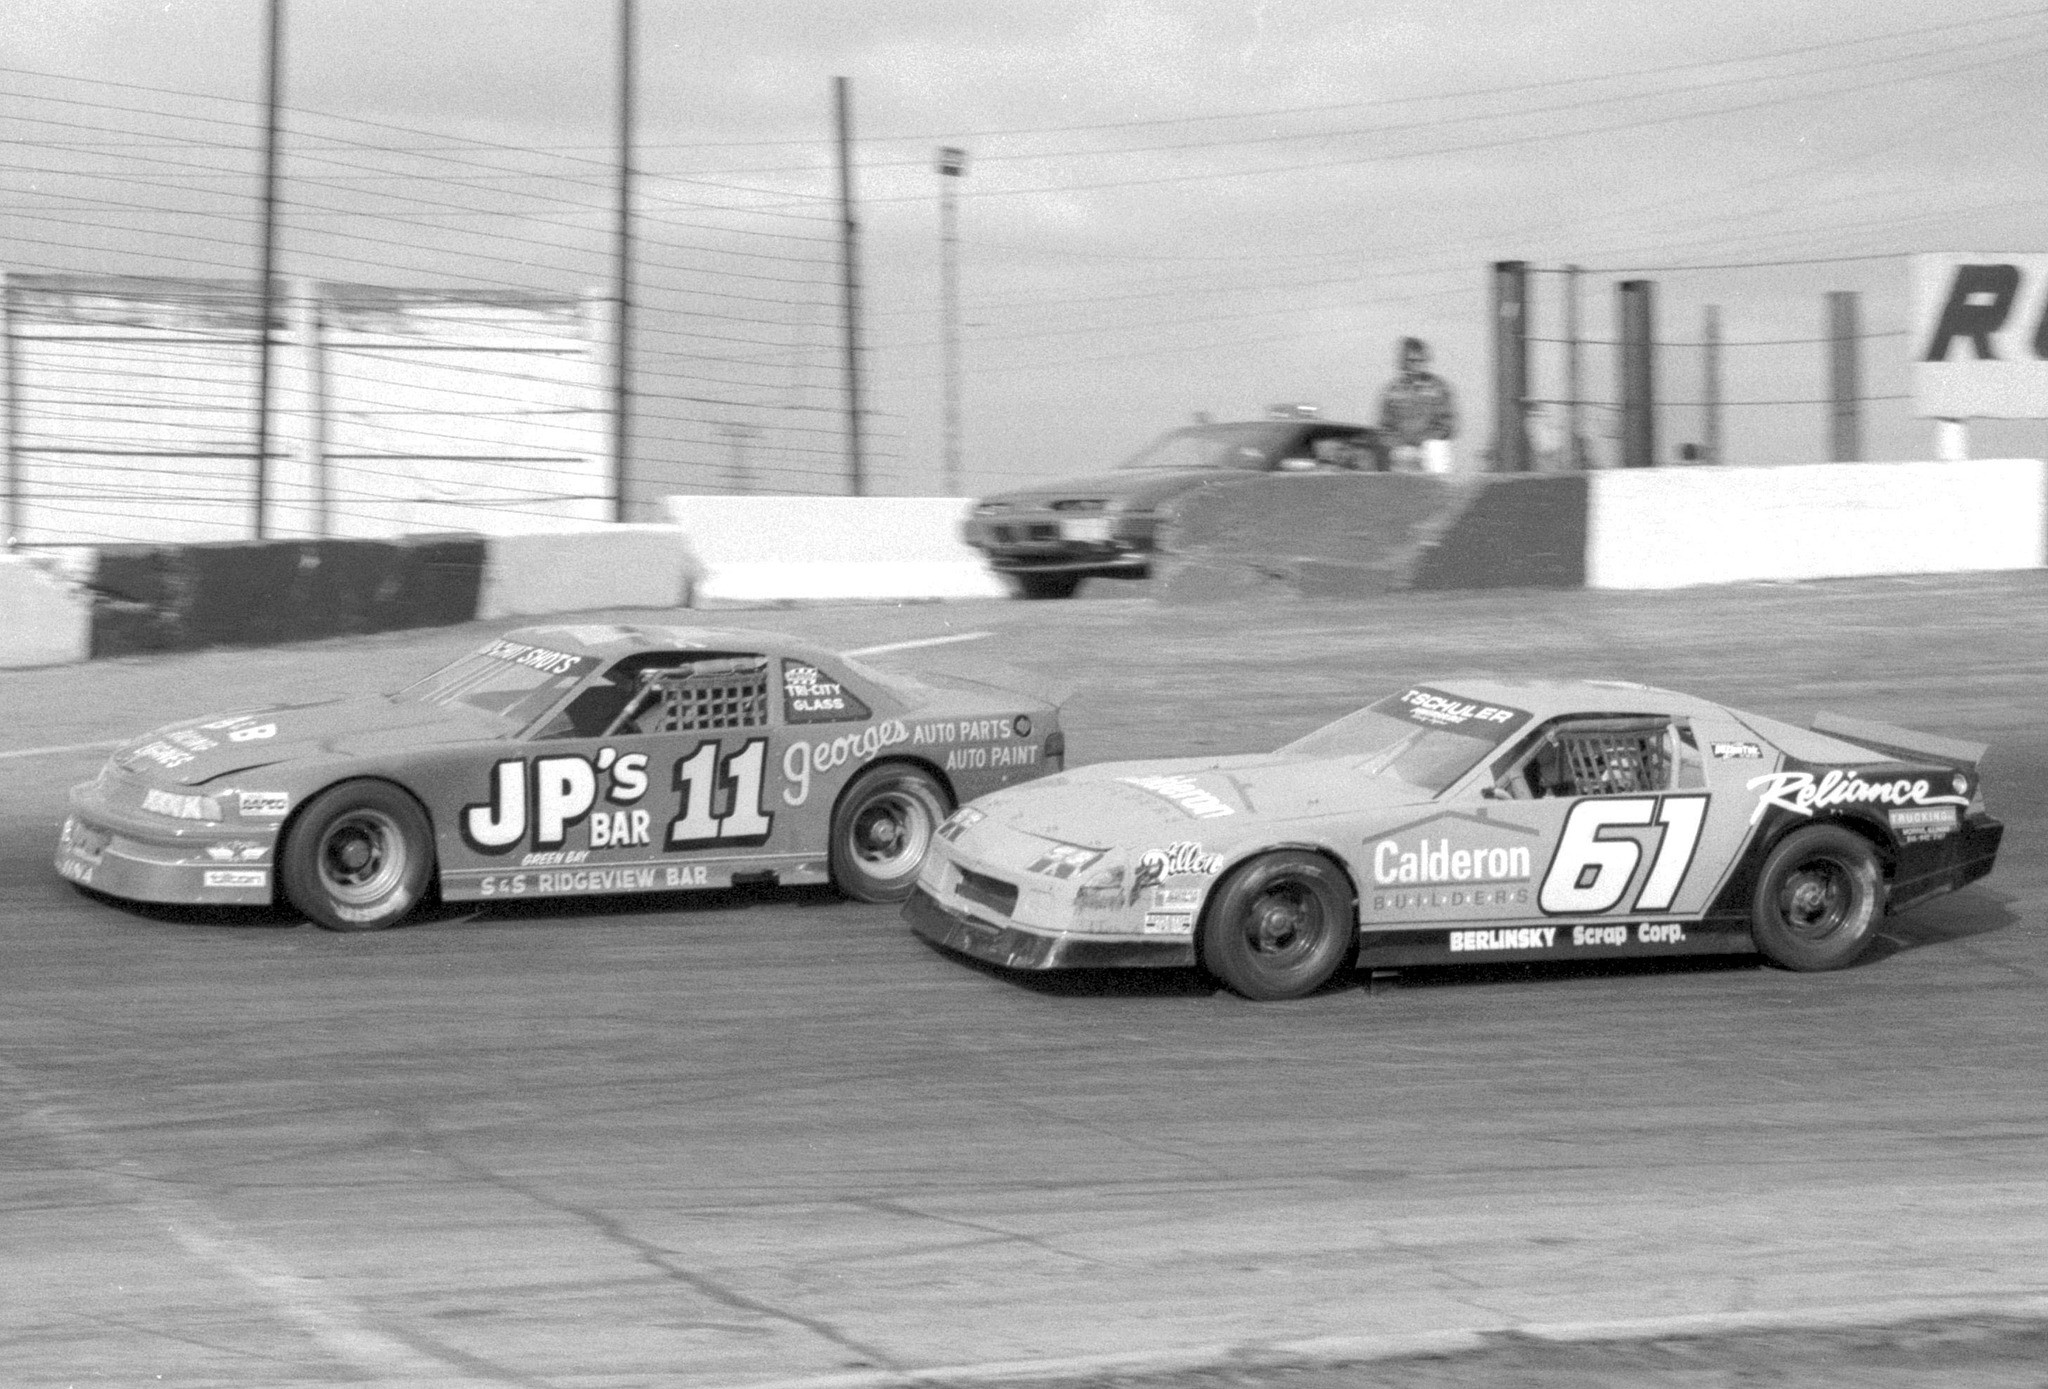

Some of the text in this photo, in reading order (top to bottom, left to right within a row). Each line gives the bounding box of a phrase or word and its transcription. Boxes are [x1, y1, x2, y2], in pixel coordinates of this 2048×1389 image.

[1918, 264, 2048, 361] R
[516, 648, 582, 674] SHOTS
[784, 684, 841, 697] TRI-CITY
[793, 698, 845, 711] GLASS
[783, 719, 1011, 806] georges AUTO PARTS
[946, 745, 1039, 771] AUTO PAINT
[668, 738, 773, 847] 11
[1746, 769, 1969, 825] Reliance
[590, 808, 651, 848] BAR
[1889, 810, 1948, 824] TRUCKING
[520, 850, 590, 866] GREEN BAY
[1374, 838, 1530, 885] Calderon
[1538, 794, 1710, 916] 61
[539, 868, 656, 892] RIDGEVIEW
[666, 866, 708, 886] BAR
[1450, 922, 1687, 951] BERLINSKY Scrap Corp.
